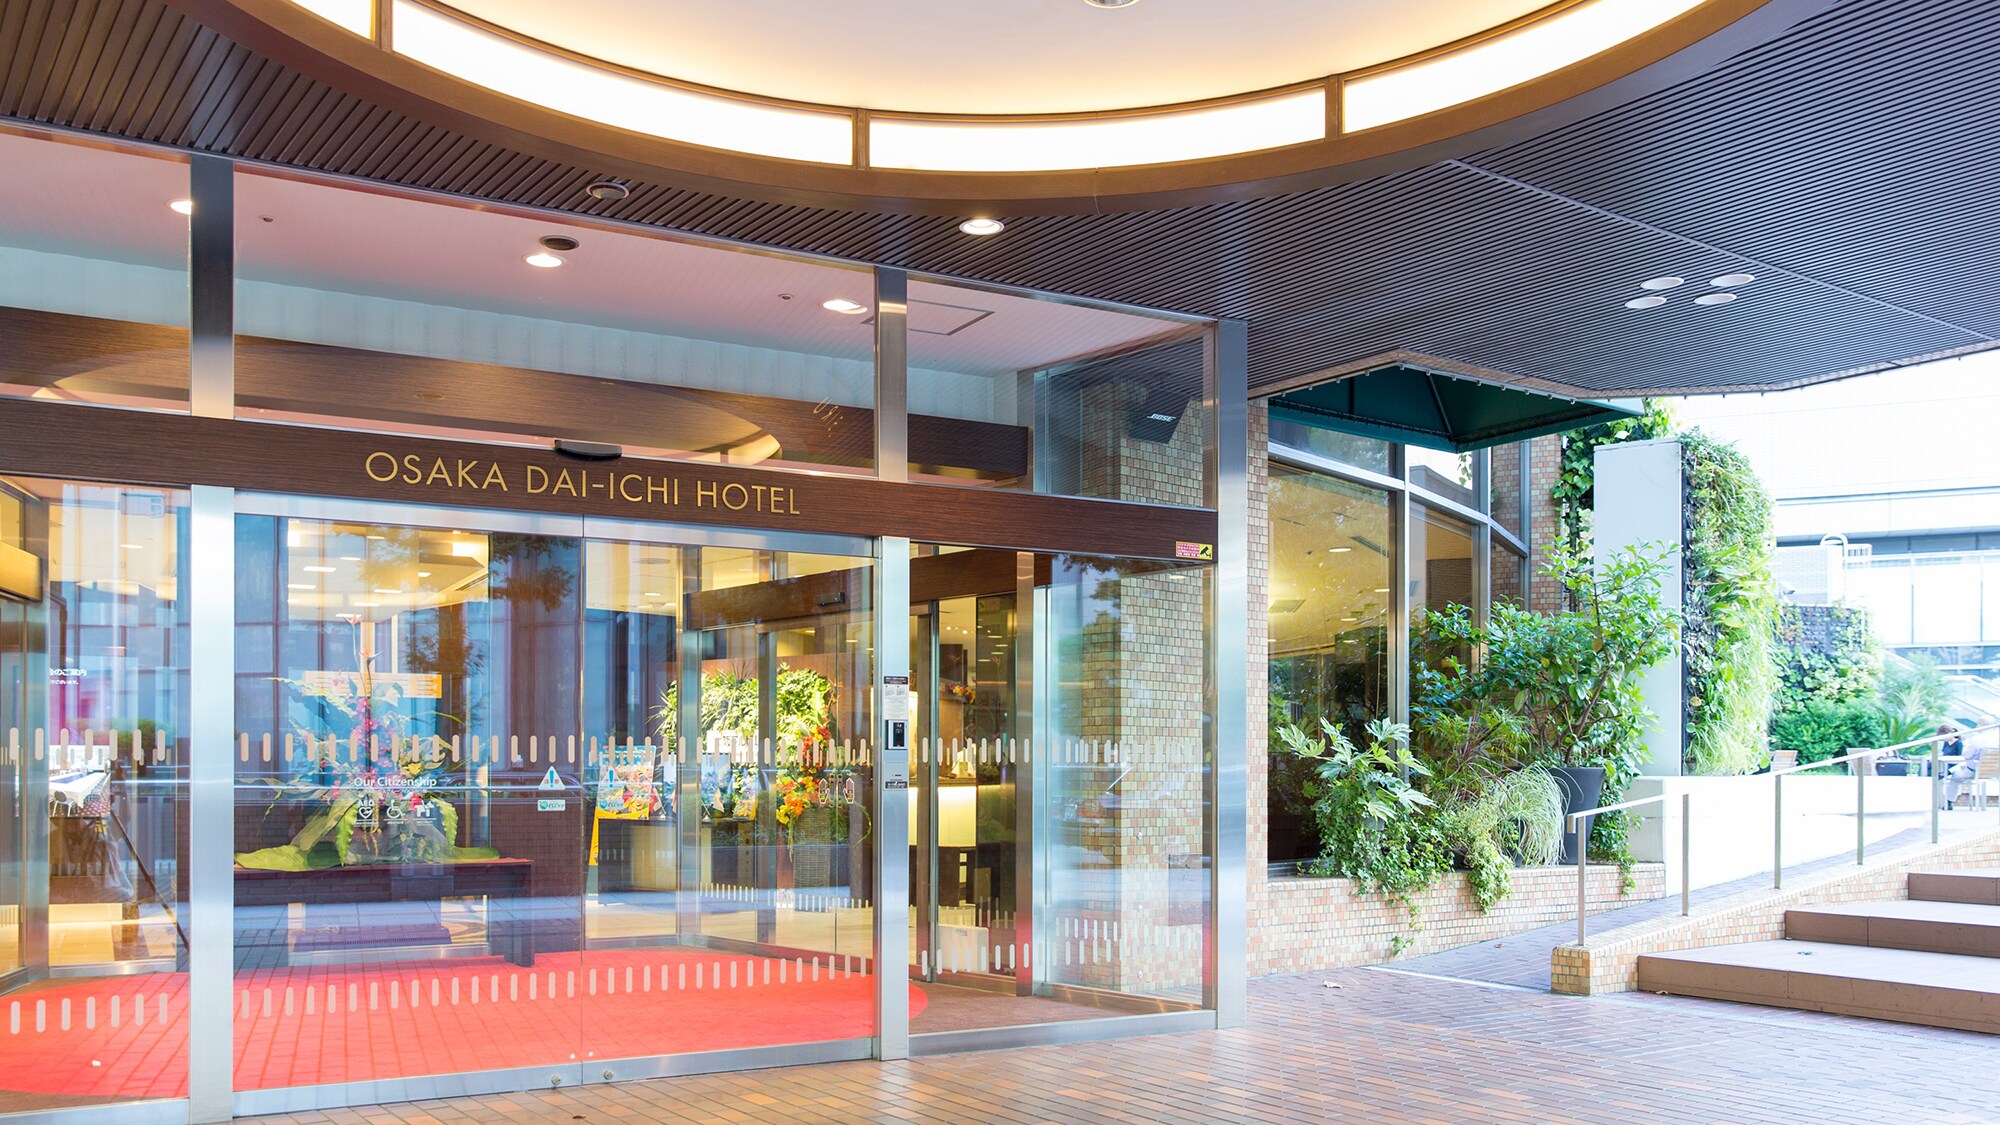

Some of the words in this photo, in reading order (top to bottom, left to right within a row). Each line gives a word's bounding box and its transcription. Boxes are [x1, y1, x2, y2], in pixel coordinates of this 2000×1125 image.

[1146, 413, 1176, 422] BOSE
[365, 451, 508, 492] OSAKA
[526, 465, 679, 505] DAI-ICHI
[697, 480, 801, 515] HOTEL
[354, 777, 375, 786] Our
[377, 776, 437, 787] Citizenship
